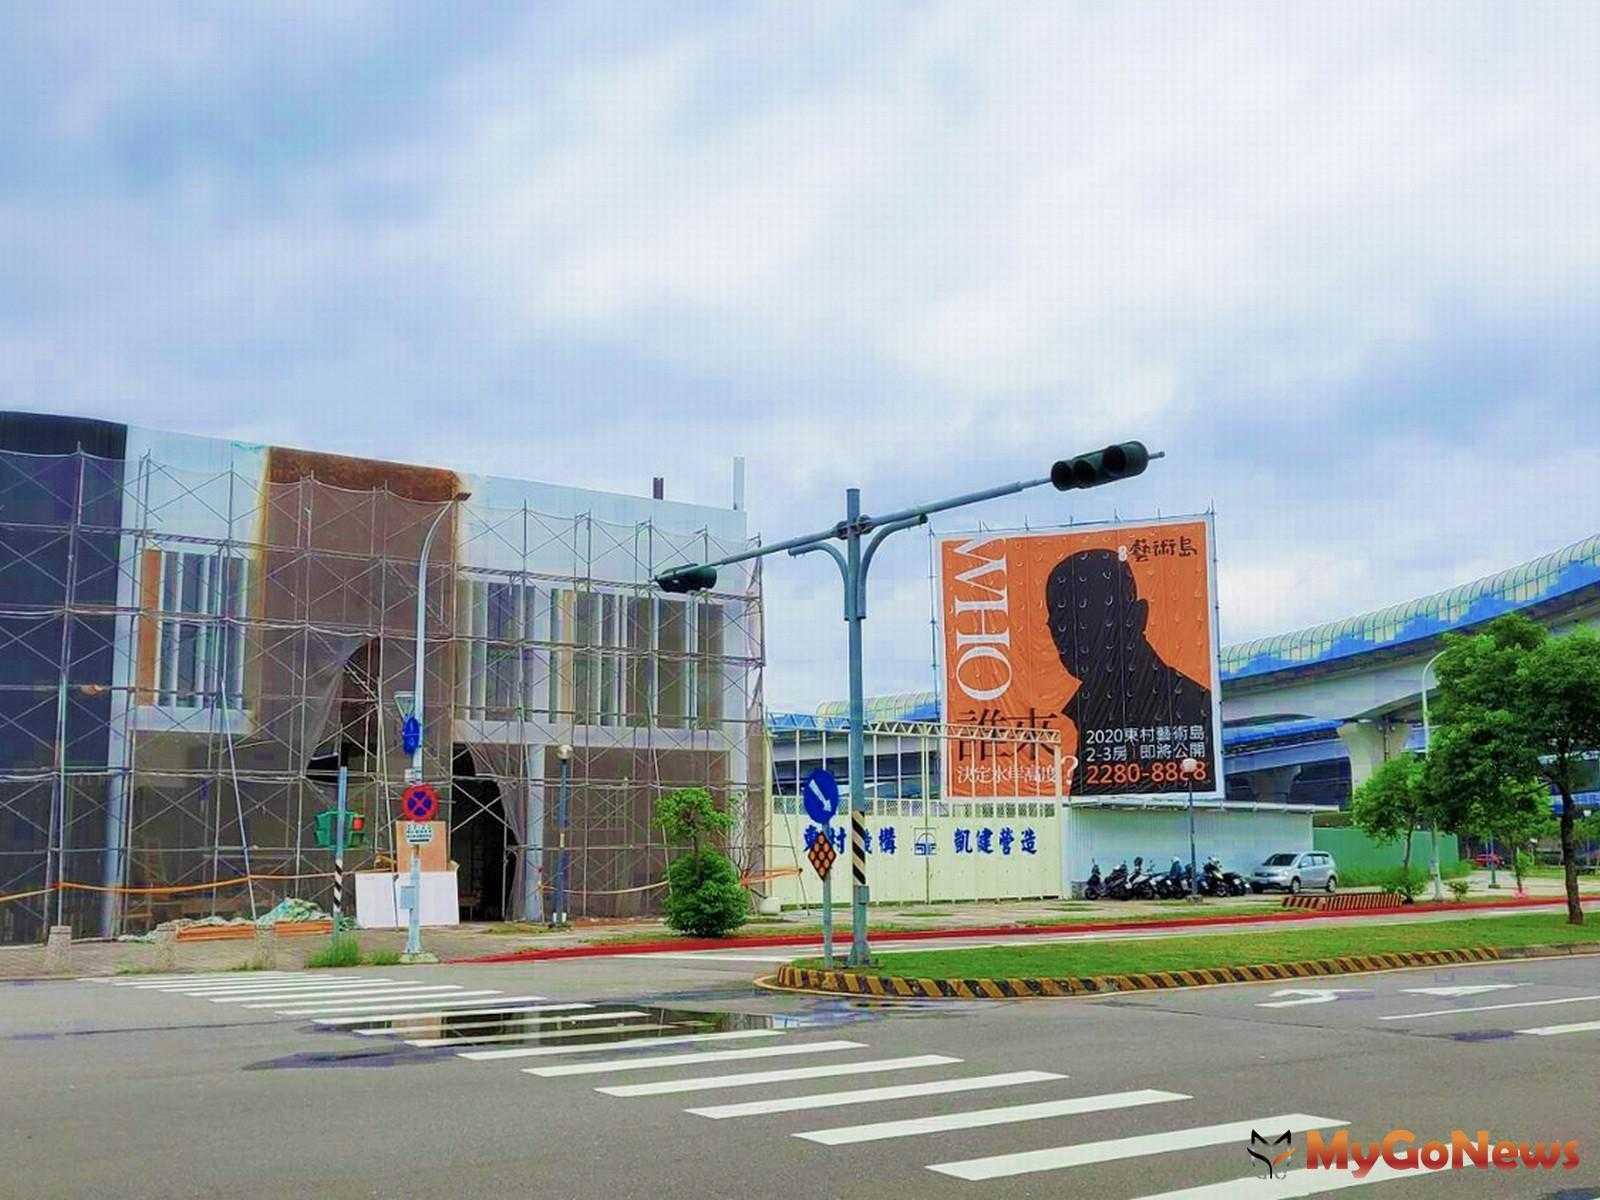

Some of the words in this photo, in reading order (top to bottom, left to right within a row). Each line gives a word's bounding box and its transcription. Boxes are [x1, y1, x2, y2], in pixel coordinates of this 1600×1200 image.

[1129, 535, 1198, 562] 藝術島
[953, 536, 1013, 702] WHO
[954, 827, 1038, 855] 凱建營造
